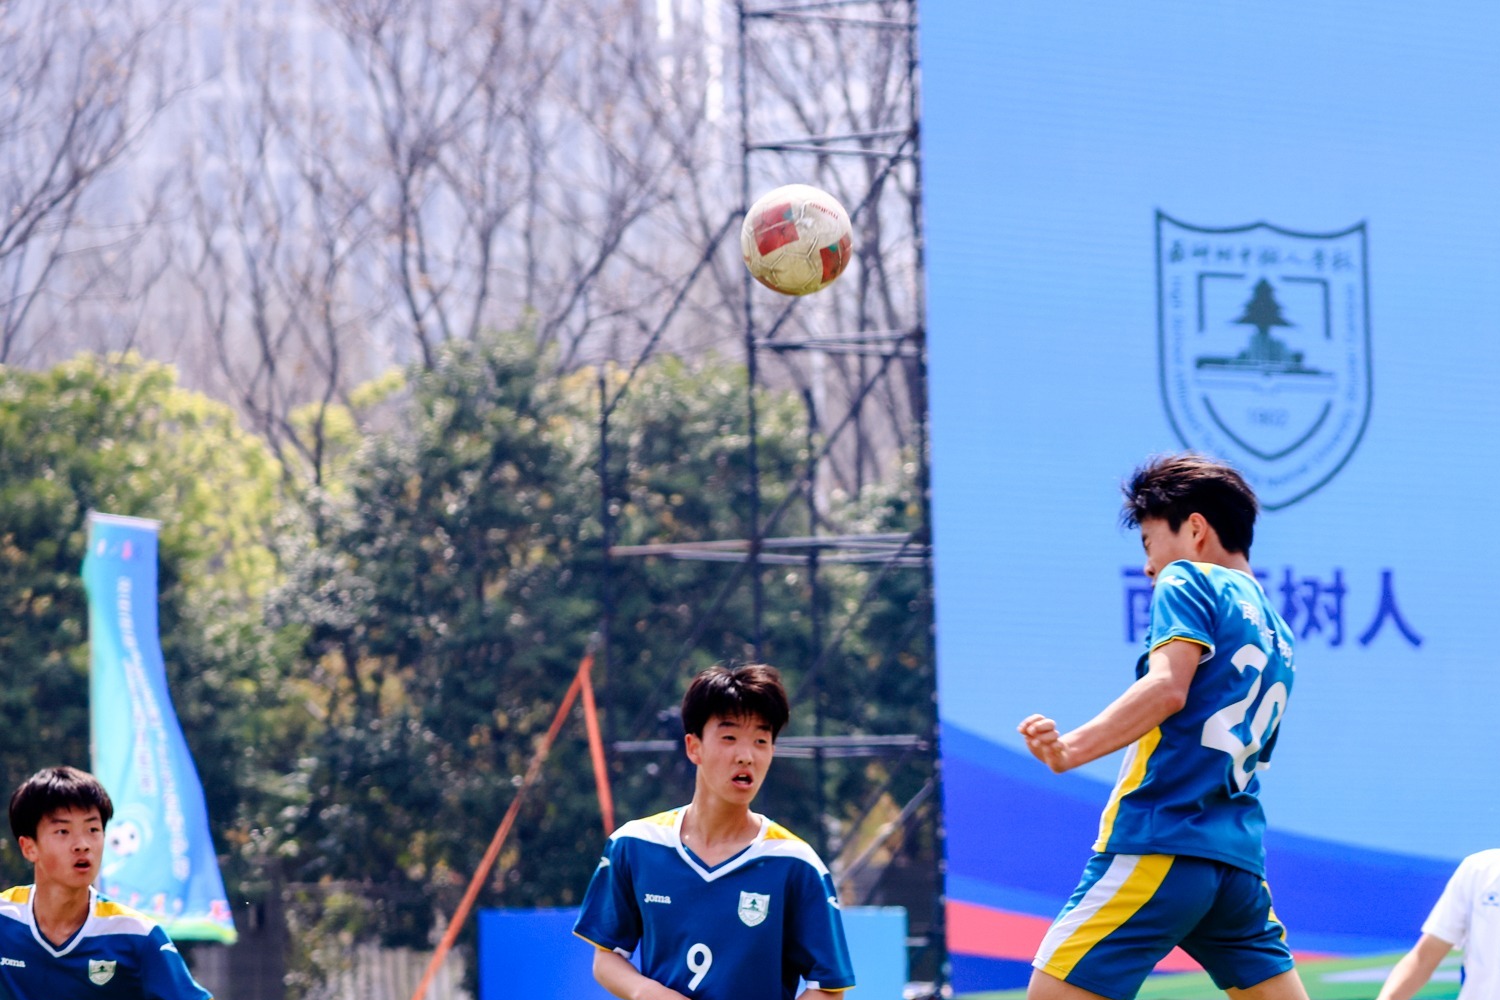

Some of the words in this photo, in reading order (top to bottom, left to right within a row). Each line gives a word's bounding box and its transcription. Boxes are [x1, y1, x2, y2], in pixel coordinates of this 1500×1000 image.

[1121, 568, 1422, 648] 树人
[1201, 644, 1288, 792] 20
[686, 942, 713, 991] 9
